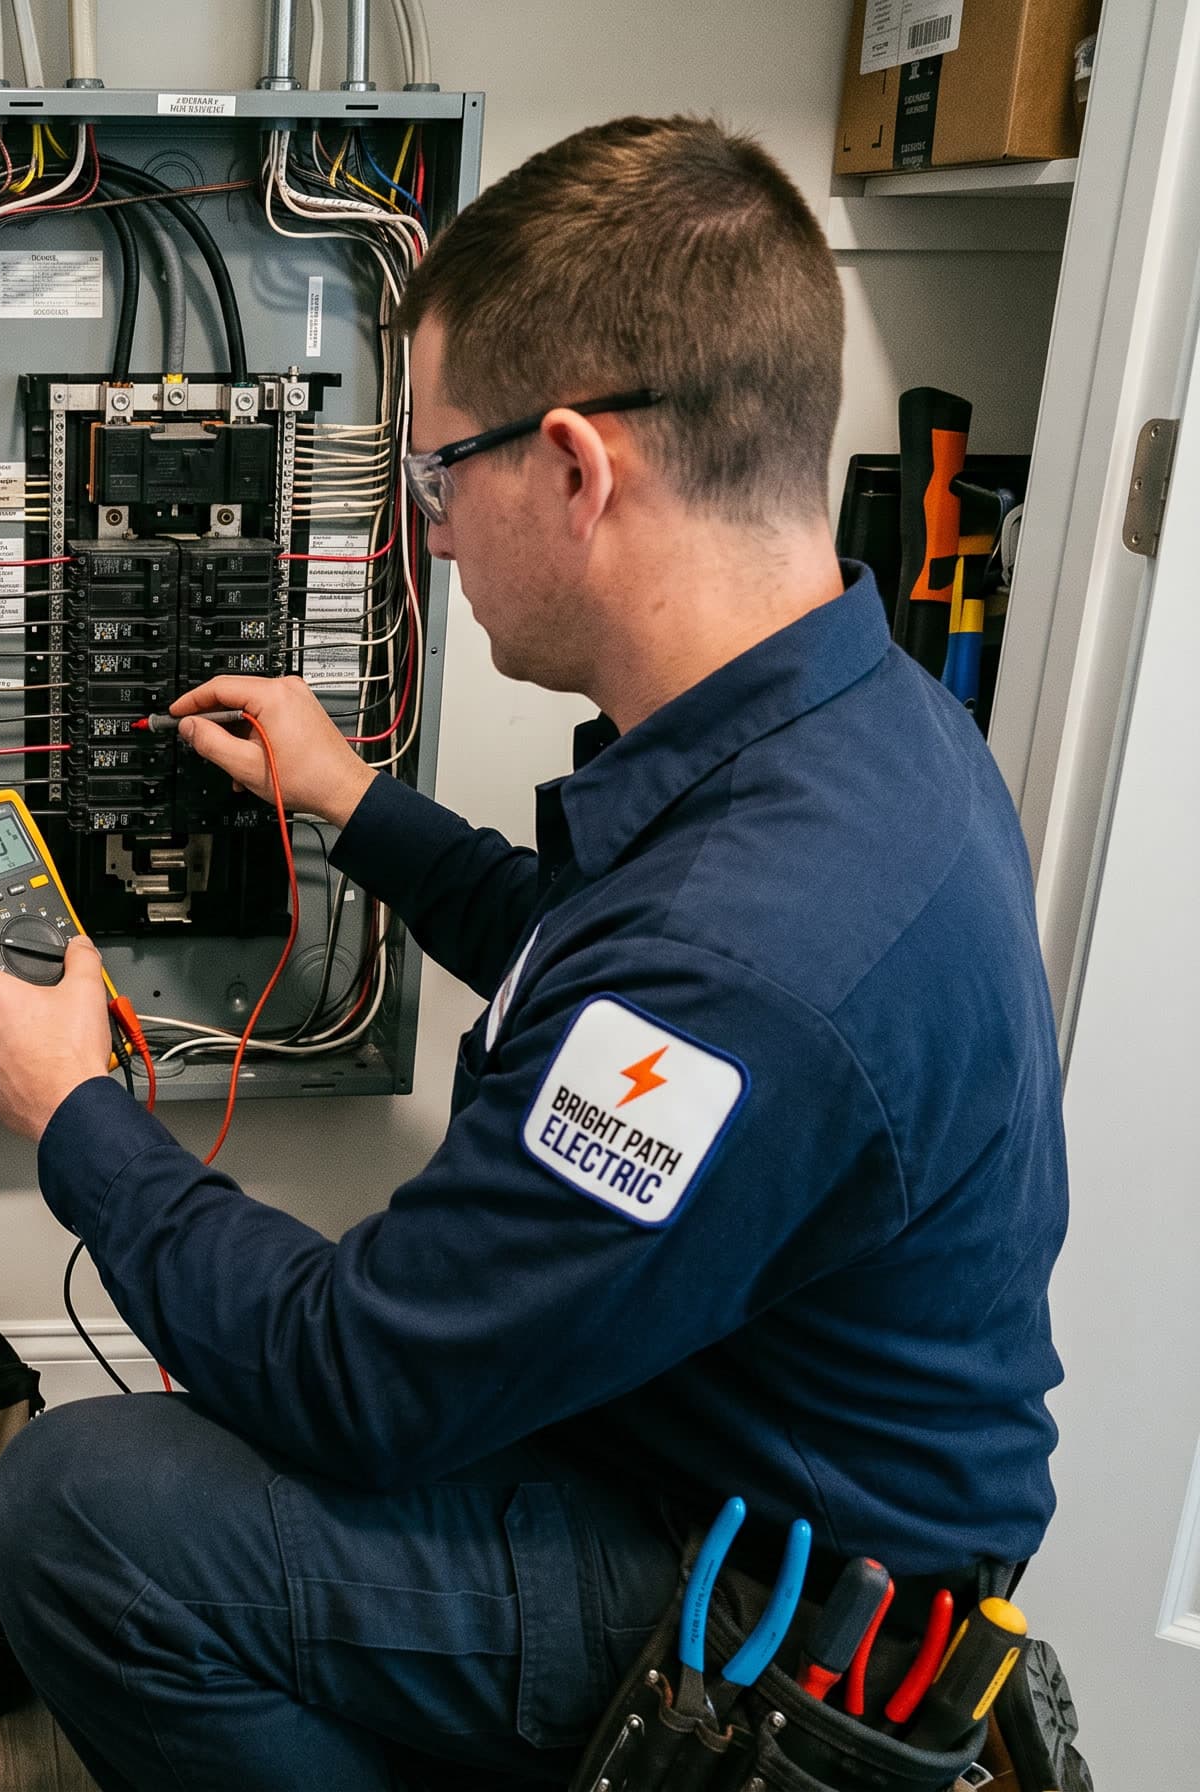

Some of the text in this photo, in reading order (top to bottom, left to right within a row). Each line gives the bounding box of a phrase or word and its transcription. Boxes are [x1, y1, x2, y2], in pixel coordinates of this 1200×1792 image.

[539, 1114, 662, 1205] ELECTRIC
[551, 1085, 683, 1176] BRIGHT PATH
